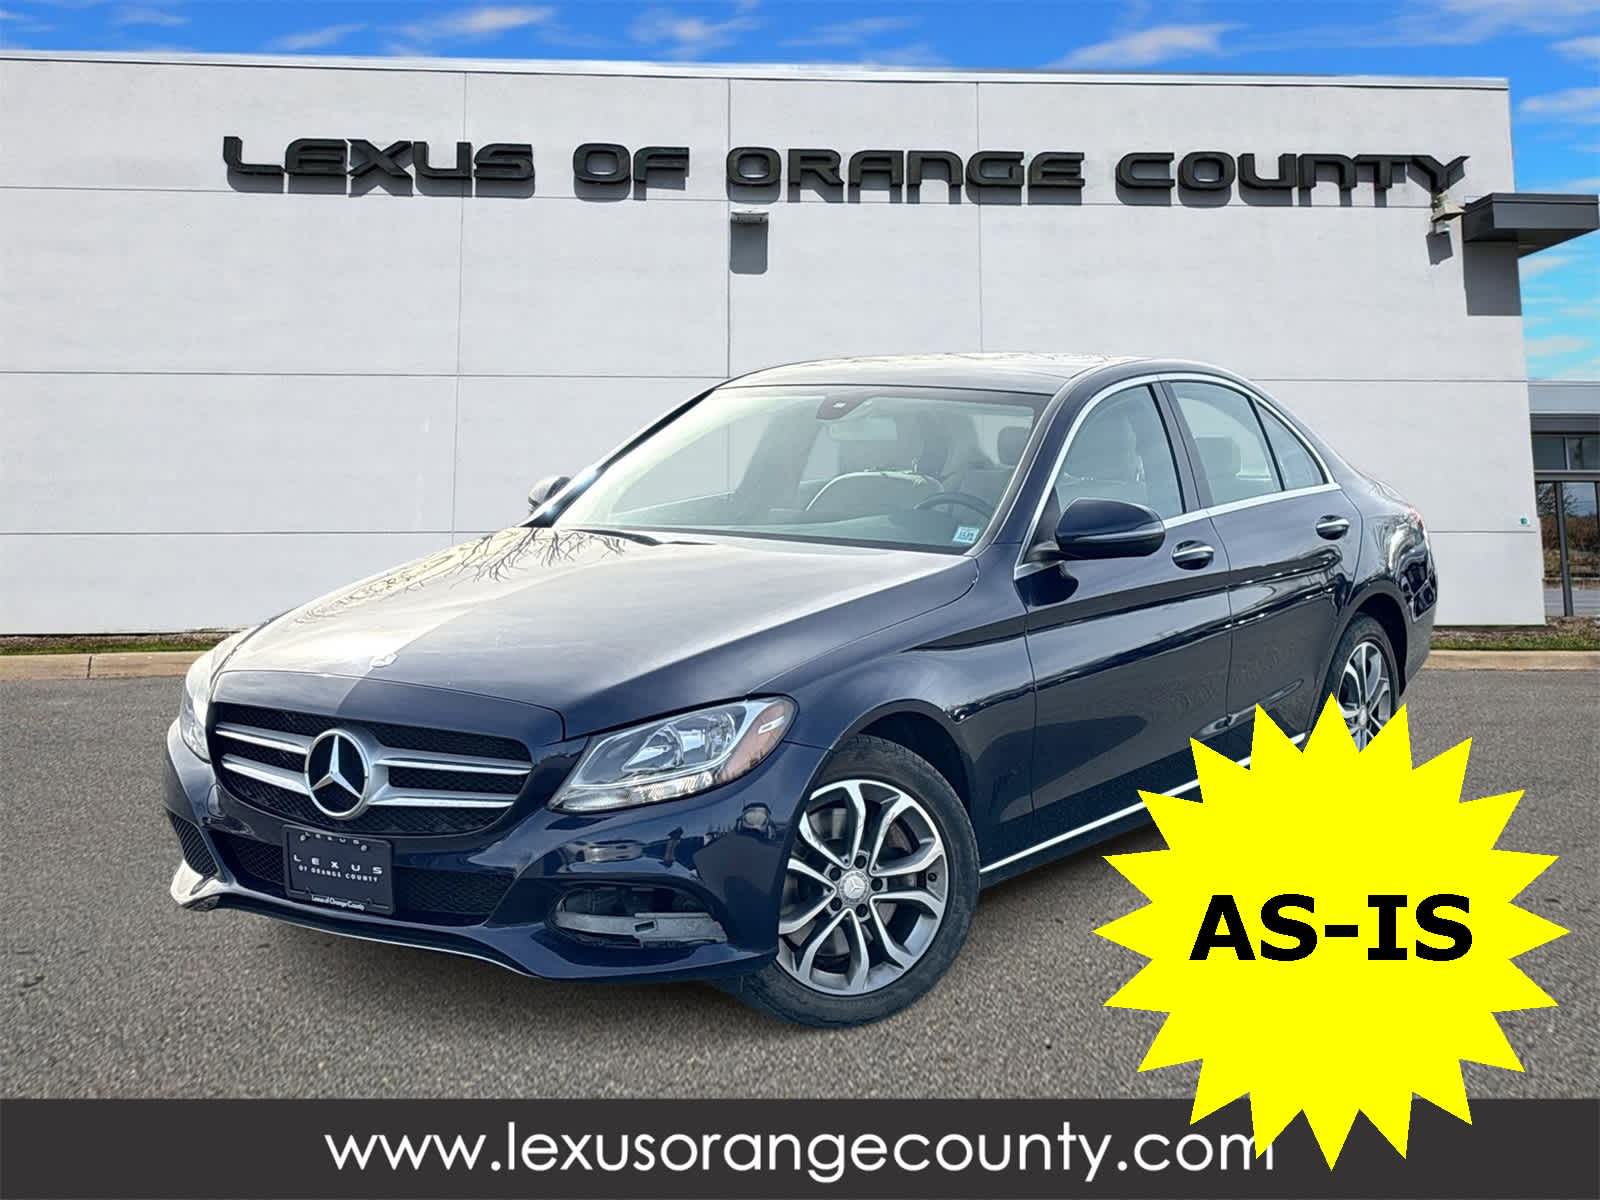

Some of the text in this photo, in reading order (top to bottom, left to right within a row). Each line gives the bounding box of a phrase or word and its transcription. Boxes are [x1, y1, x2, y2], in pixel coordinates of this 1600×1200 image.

[222, 136, 1468, 192] LEXUS OF ORANGE COUNTY
[293, 854, 383, 875] LEXUS
[311, 867, 342, 878] ORANGE
[345, 873, 378, 882] COUNTY
